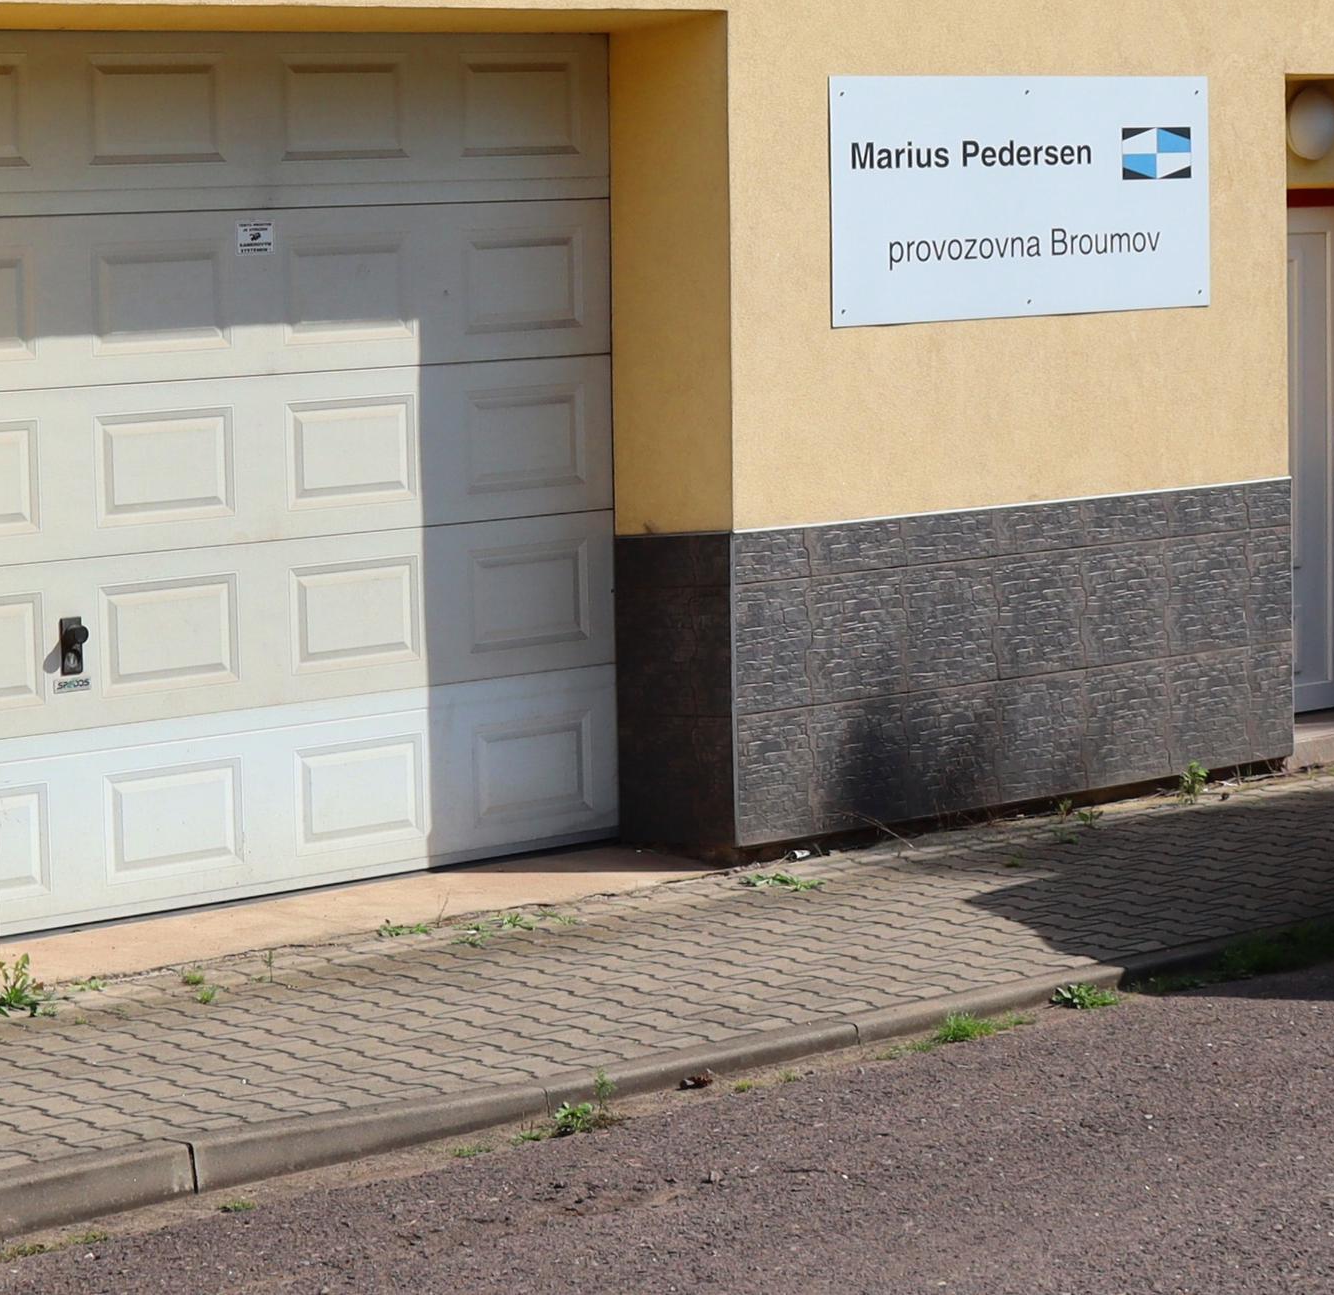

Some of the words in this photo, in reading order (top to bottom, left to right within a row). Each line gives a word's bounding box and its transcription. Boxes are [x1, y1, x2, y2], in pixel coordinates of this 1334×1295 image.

[851, 141, 949, 170] Marius
[962, 139, 1092, 167] Pedersen
[888, 235, 1041, 271] provozovna
[1051, 227, 1161, 256] Broumov
